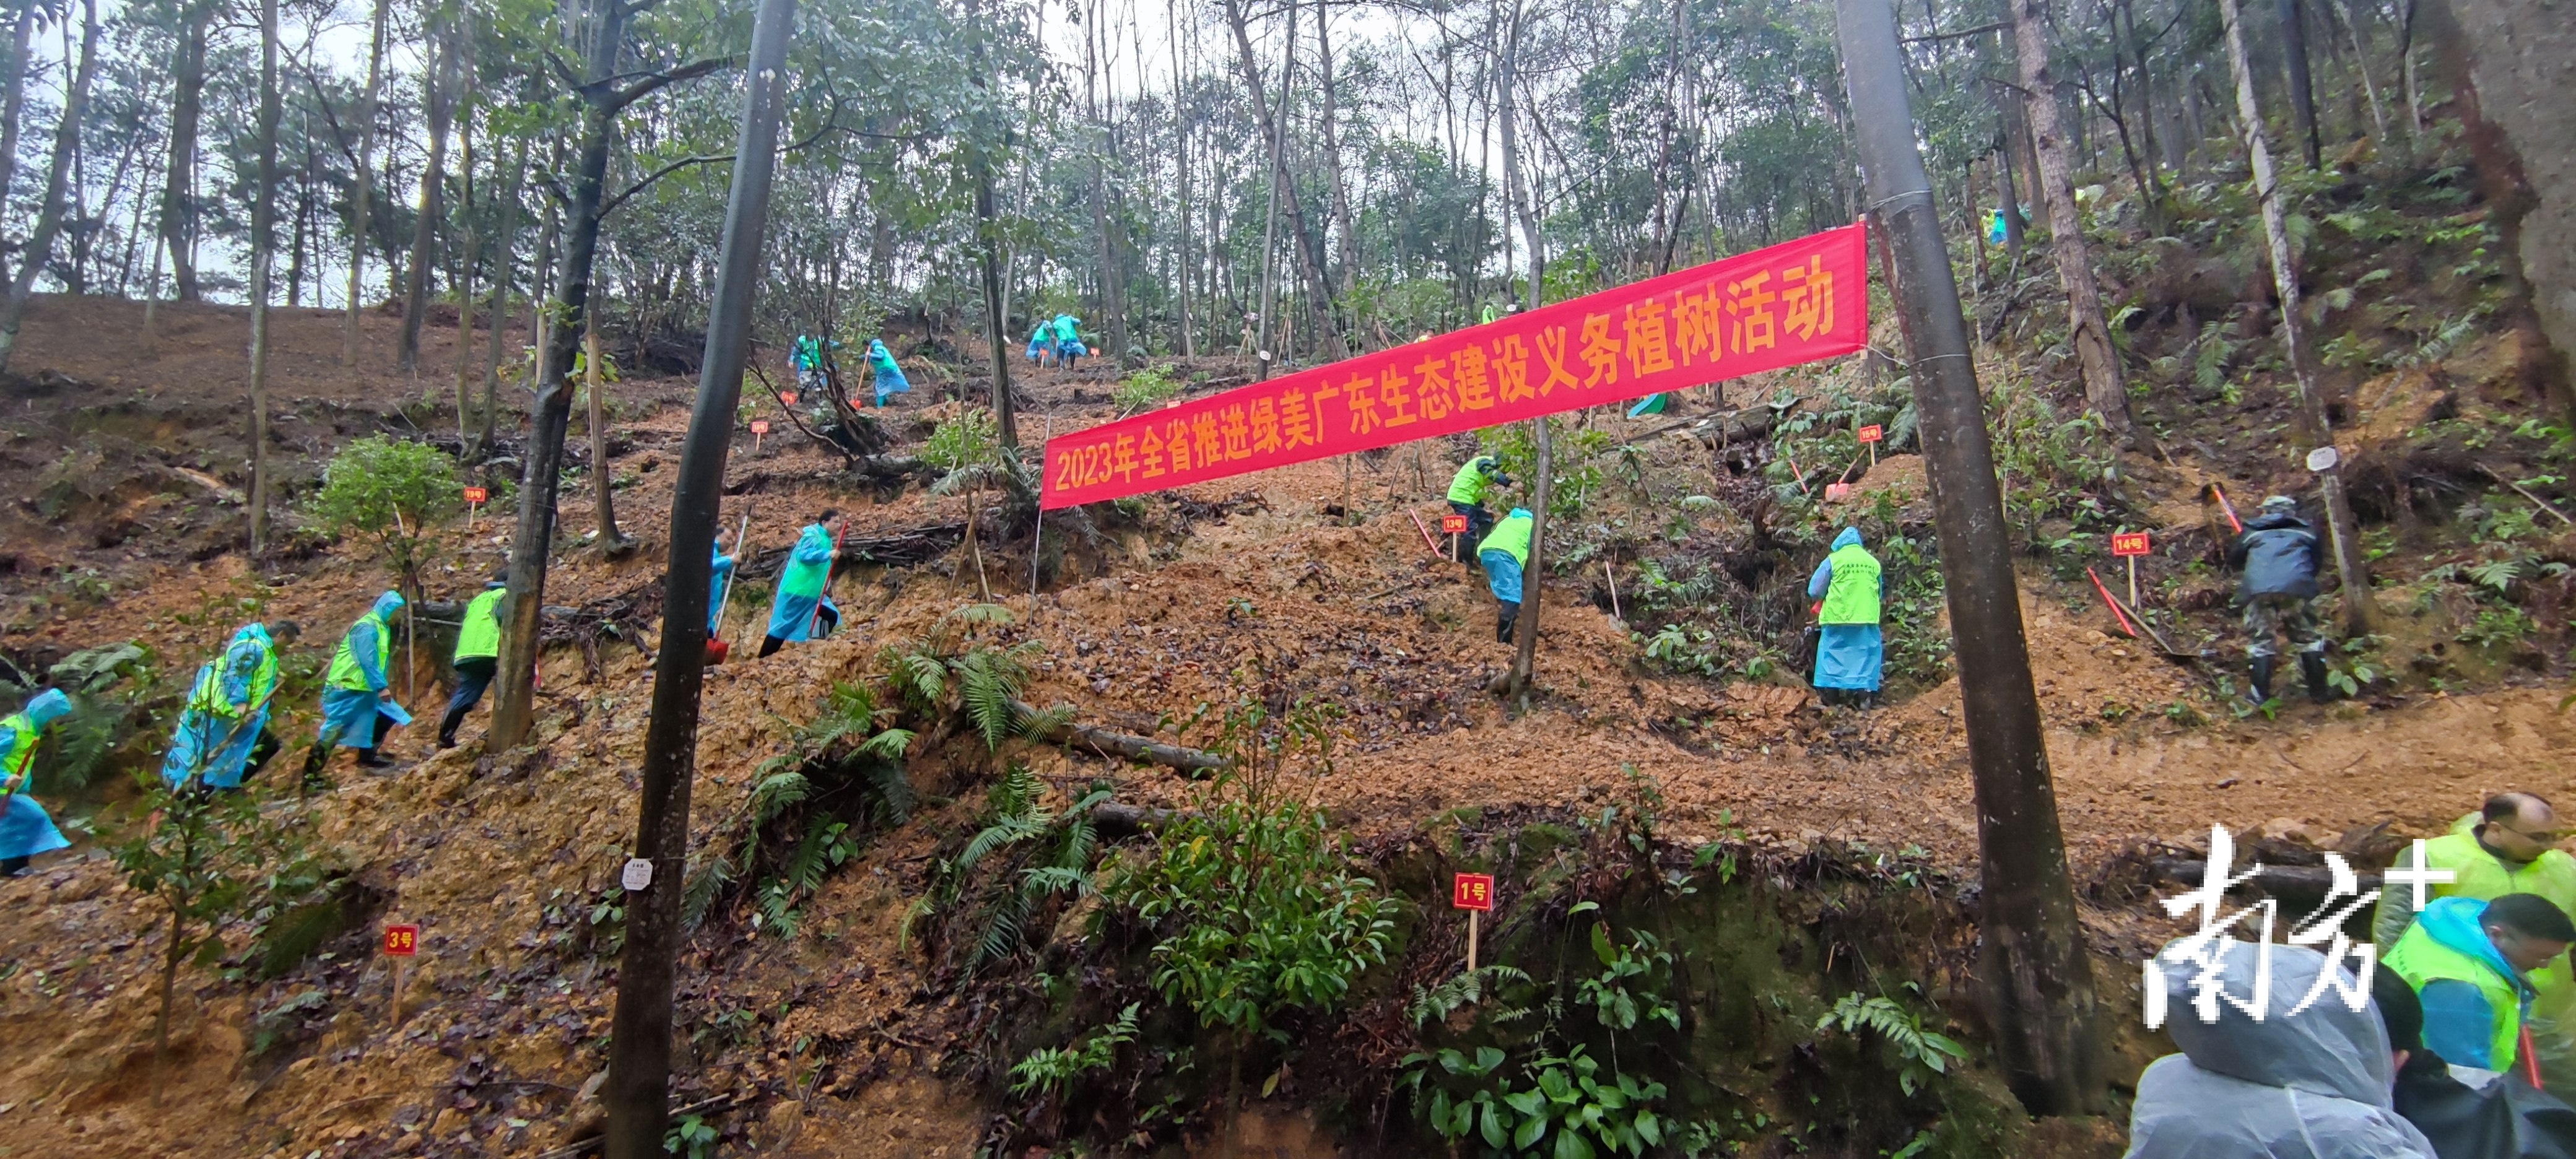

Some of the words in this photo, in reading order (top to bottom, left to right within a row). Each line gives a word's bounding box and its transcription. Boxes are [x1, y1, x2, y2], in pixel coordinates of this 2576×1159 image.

[1056, 254, 1834, 492] 2023年全省推进绿美广东生态建设义务植树活动
[1861, 428, 1878, 439] 15号
[466, 490, 482, 499] 19号
[1446, 519, 1463, 529] 13号
[2117, 537, 2143, 551] 14号
[1461, 882, 1486, 901] 1号
[389, 931, 412, 948] 3号
